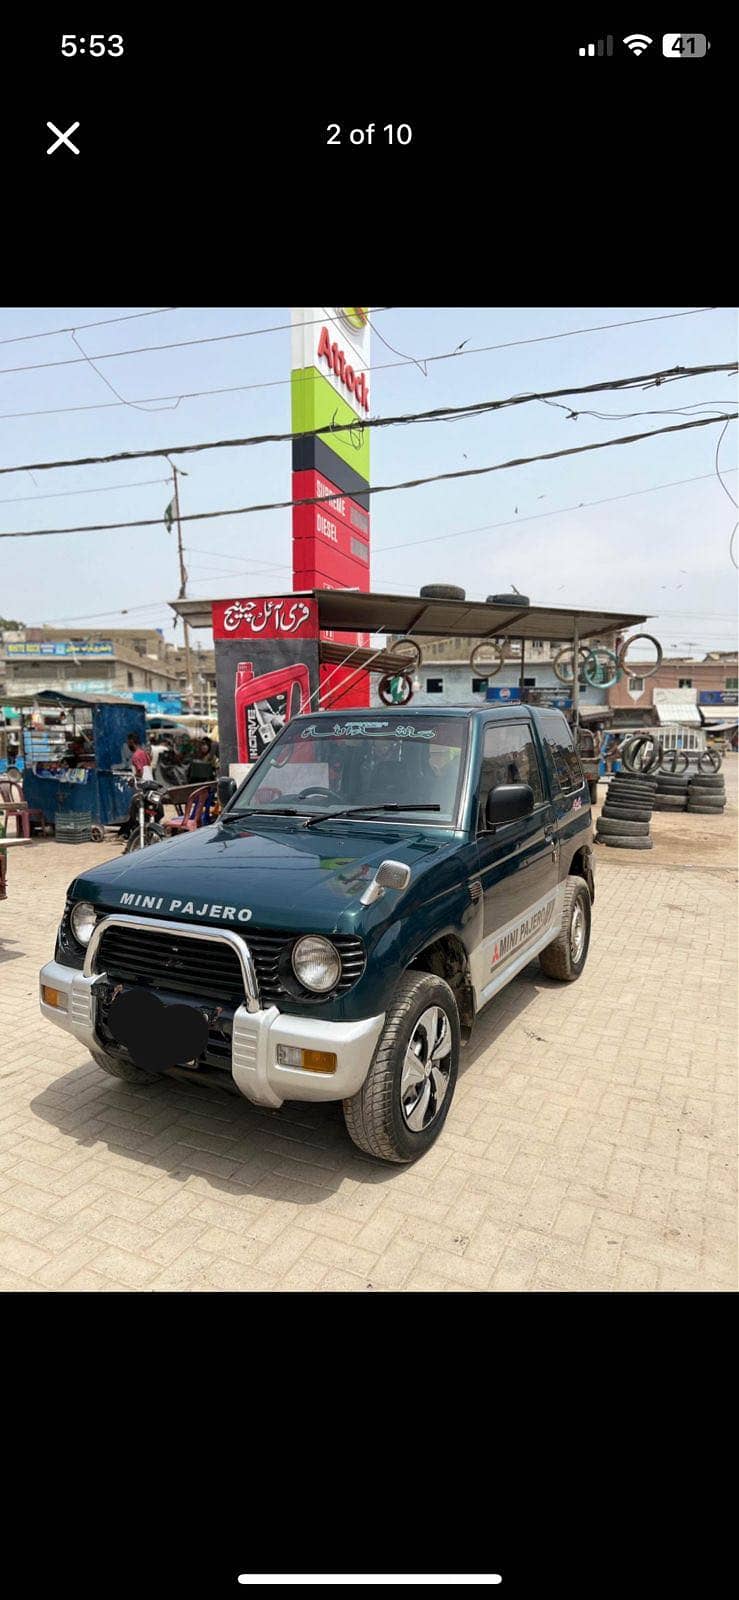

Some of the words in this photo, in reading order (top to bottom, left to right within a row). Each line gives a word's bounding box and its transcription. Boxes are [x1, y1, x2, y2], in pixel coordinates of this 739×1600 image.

[317, 326, 369, 413] Attock
[316, 512, 338, 543] DIESEL
[280, 603, 310, 633] فری
[120, 892, 163, 910] MINI
[169, 899, 253, 922] PAJERO
[499, 928, 519, 958] MINI
